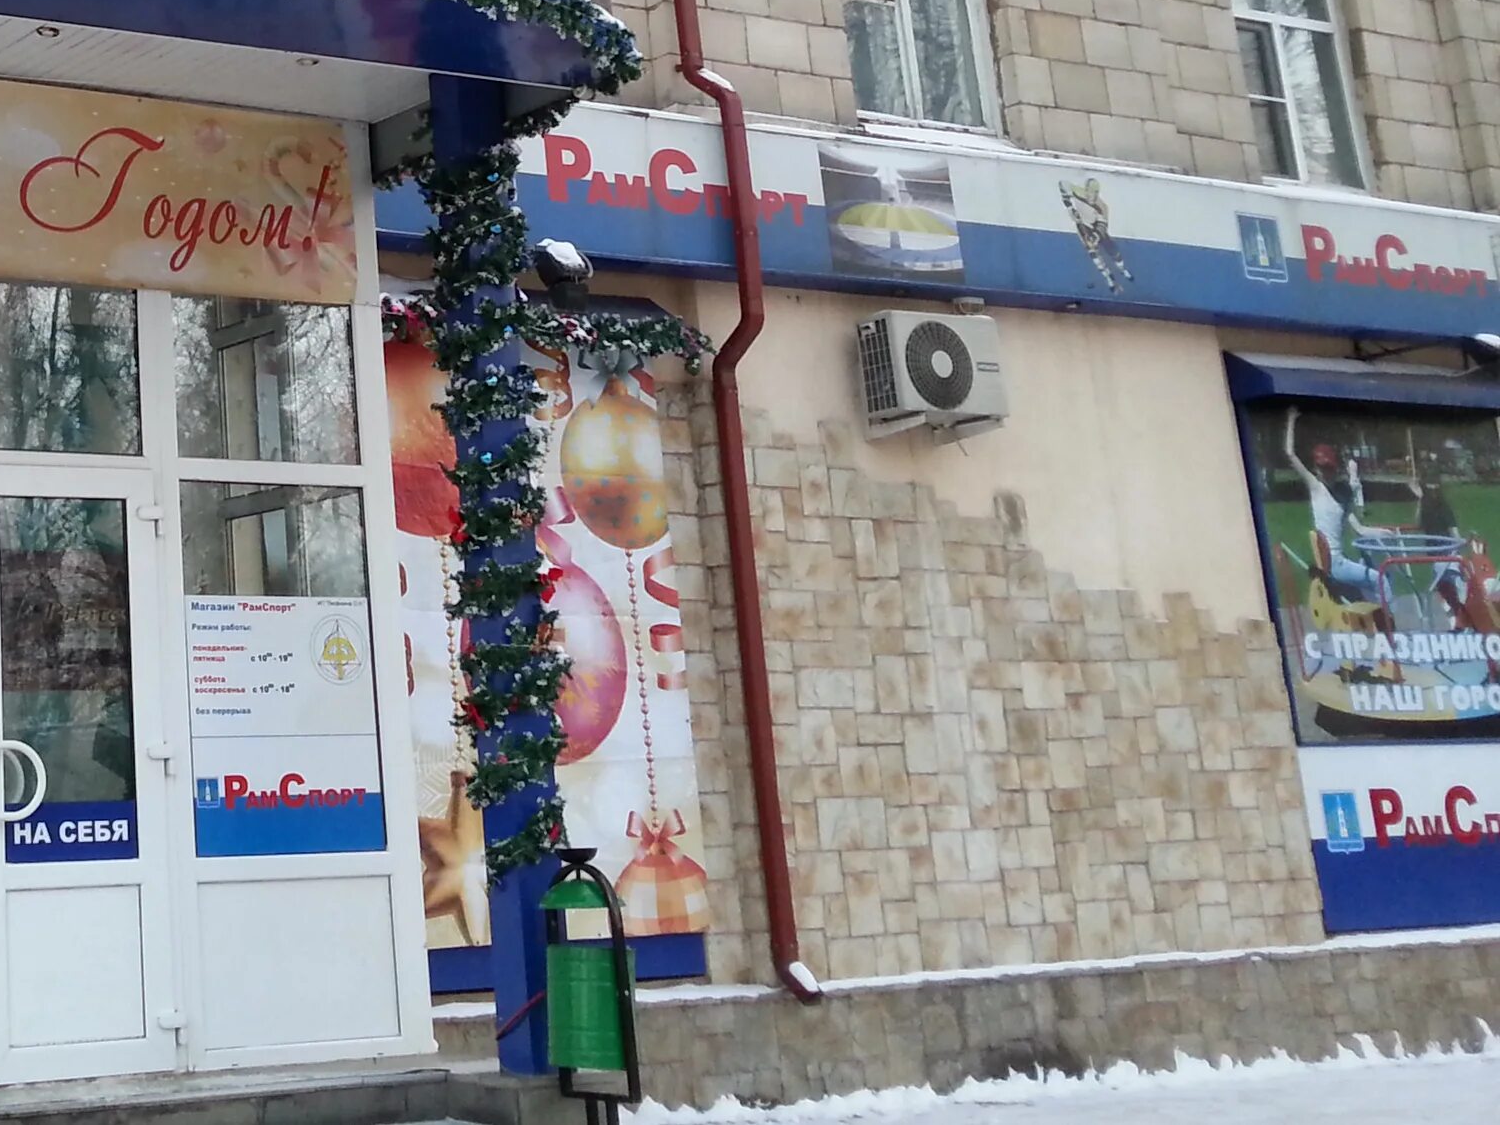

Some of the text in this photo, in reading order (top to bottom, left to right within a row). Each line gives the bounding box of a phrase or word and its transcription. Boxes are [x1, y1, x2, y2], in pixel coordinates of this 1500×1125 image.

[542, 133, 809, 227] РамСпрт
[18, 126, 333, 272] Годом!
[190, 602, 235, 612] Магазин
[1303, 632, 1323, 658] С
[194, 676, 227, 685] суббота
[1349, 684, 1424, 711] НАШ
[195, 707, 211, 716] без
[13, 819, 129, 845] НА СЕБЯ
